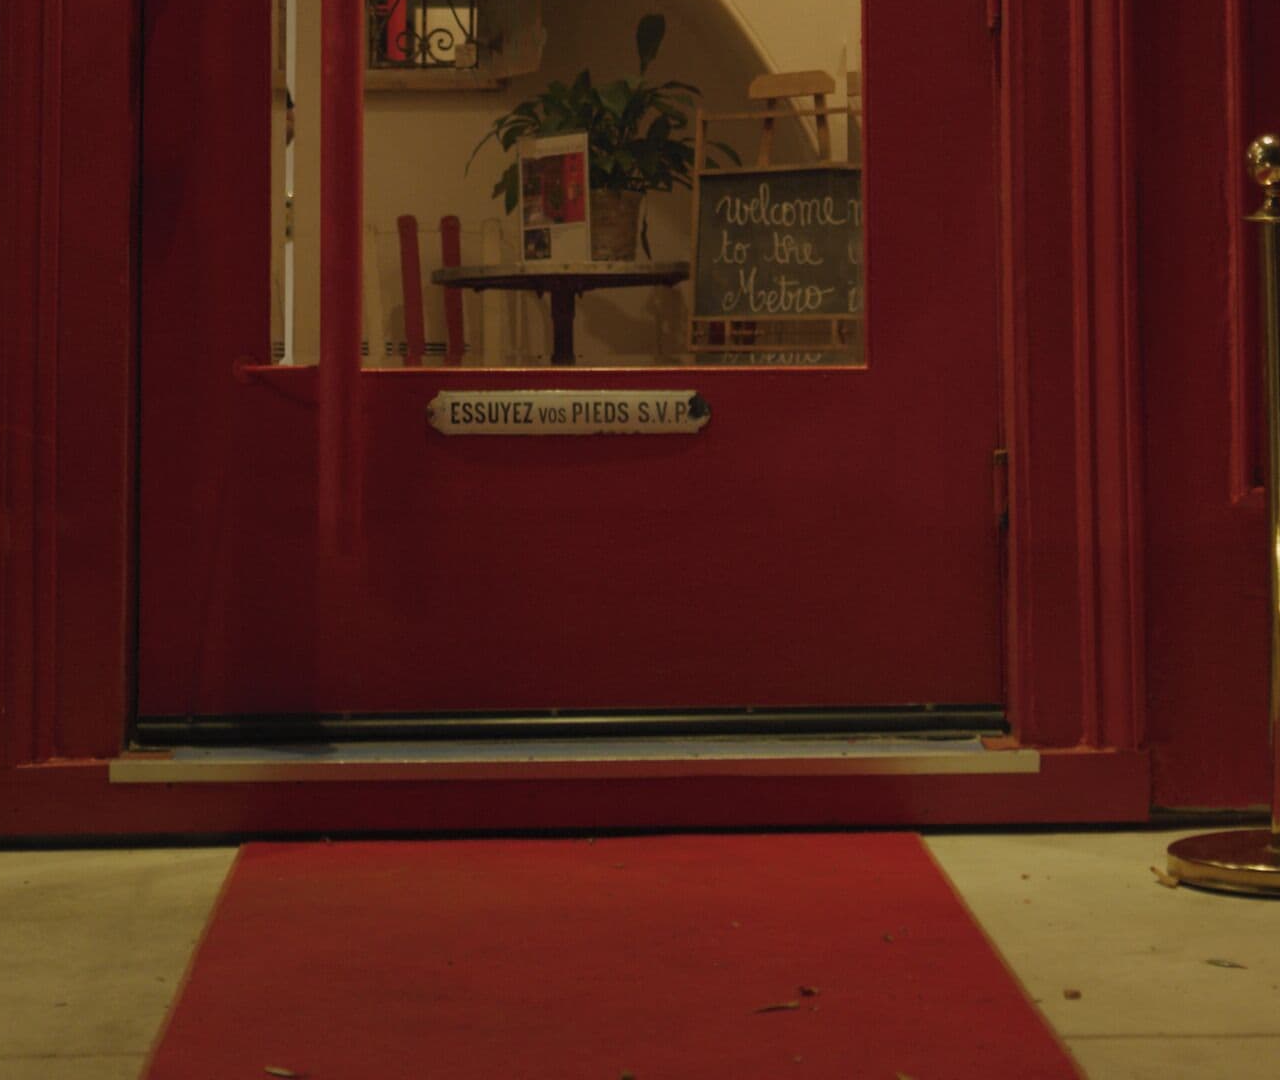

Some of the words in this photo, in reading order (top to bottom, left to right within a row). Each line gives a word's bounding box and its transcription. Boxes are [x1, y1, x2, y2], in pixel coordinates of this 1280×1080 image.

[713, 230, 751, 264] to
[764, 232, 824, 264] the
[722, 267, 835, 312] Metro
[451, 401, 533, 424] ESSUYEZ
[572, 402, 629, 424] PIEDS
